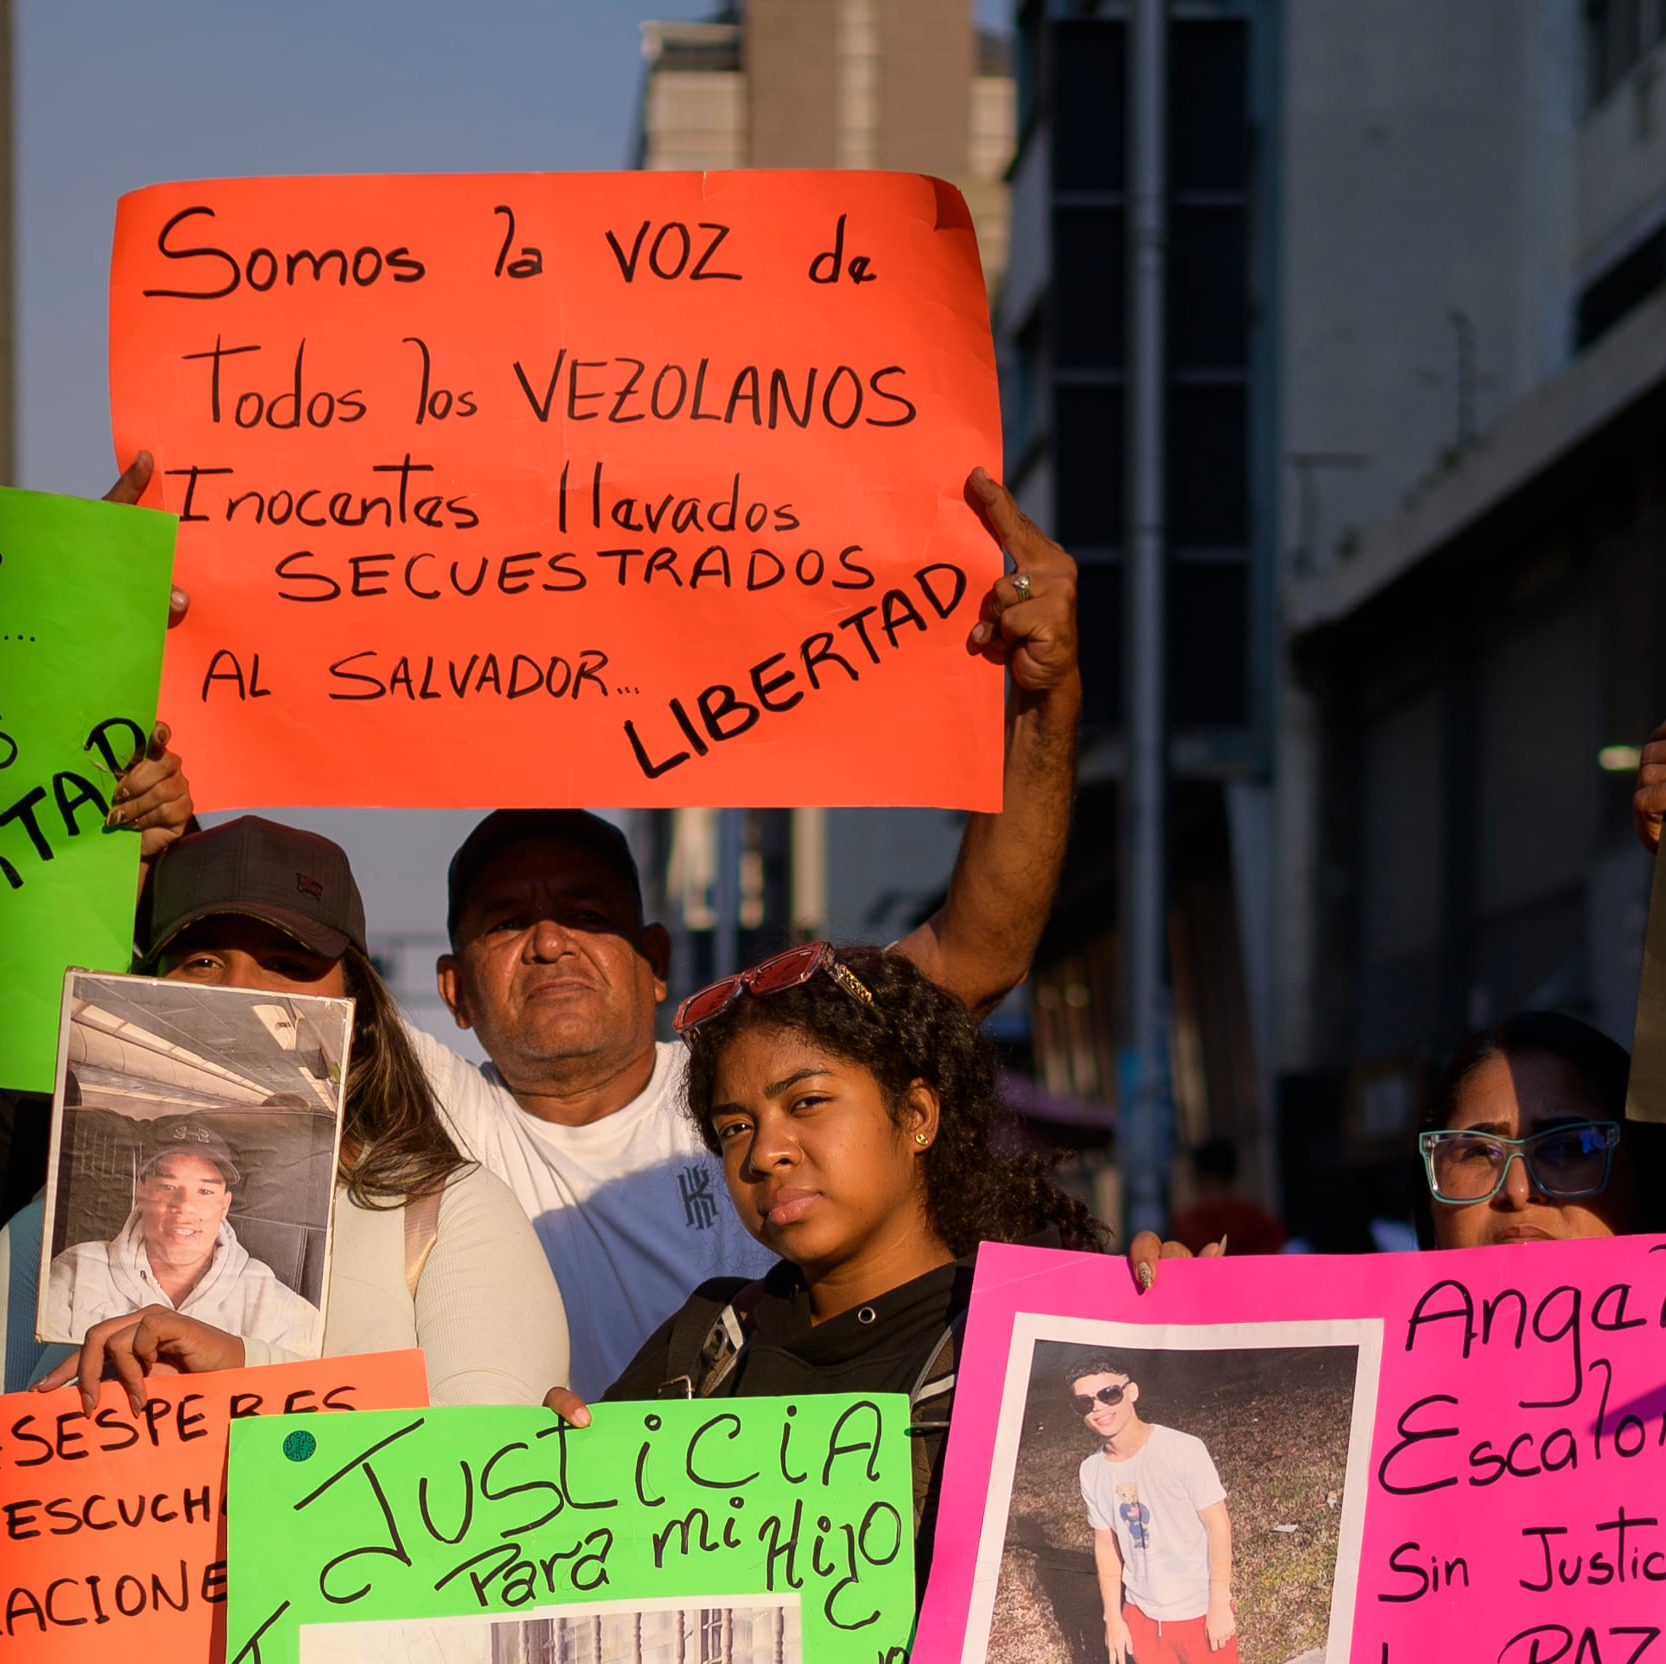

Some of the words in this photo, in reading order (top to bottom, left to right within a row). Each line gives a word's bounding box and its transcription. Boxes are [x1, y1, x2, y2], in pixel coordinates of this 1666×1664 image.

[143, 206, 425, 300] Somos
[493, 205, 543, 280] la
[605, 221, 743, 283] VOZ
[809, 213, 877, 284] de
[182, 334, 367, 429] Todos
[401, 336, 478, 427] los
[513, 348, 916, 432] VEZOLANOS
[165, 453, 479, 529] Inocentes
[558, 459, 801, 535] llevados
[275, 545, 874, 603] SECUESTRADOS
[201, 649, 272, 702] AL
[328, 649, 640, 703] SALVADOR...
[621, 561, 967, 780] LIBERTAD
[2, 1485, 226, 1541] ESCUCH
[434, 1526, 613, 1608] Para
[654, 1497, 741, 1567] mi
[1378, 1540, 1470, 1604] Sin
